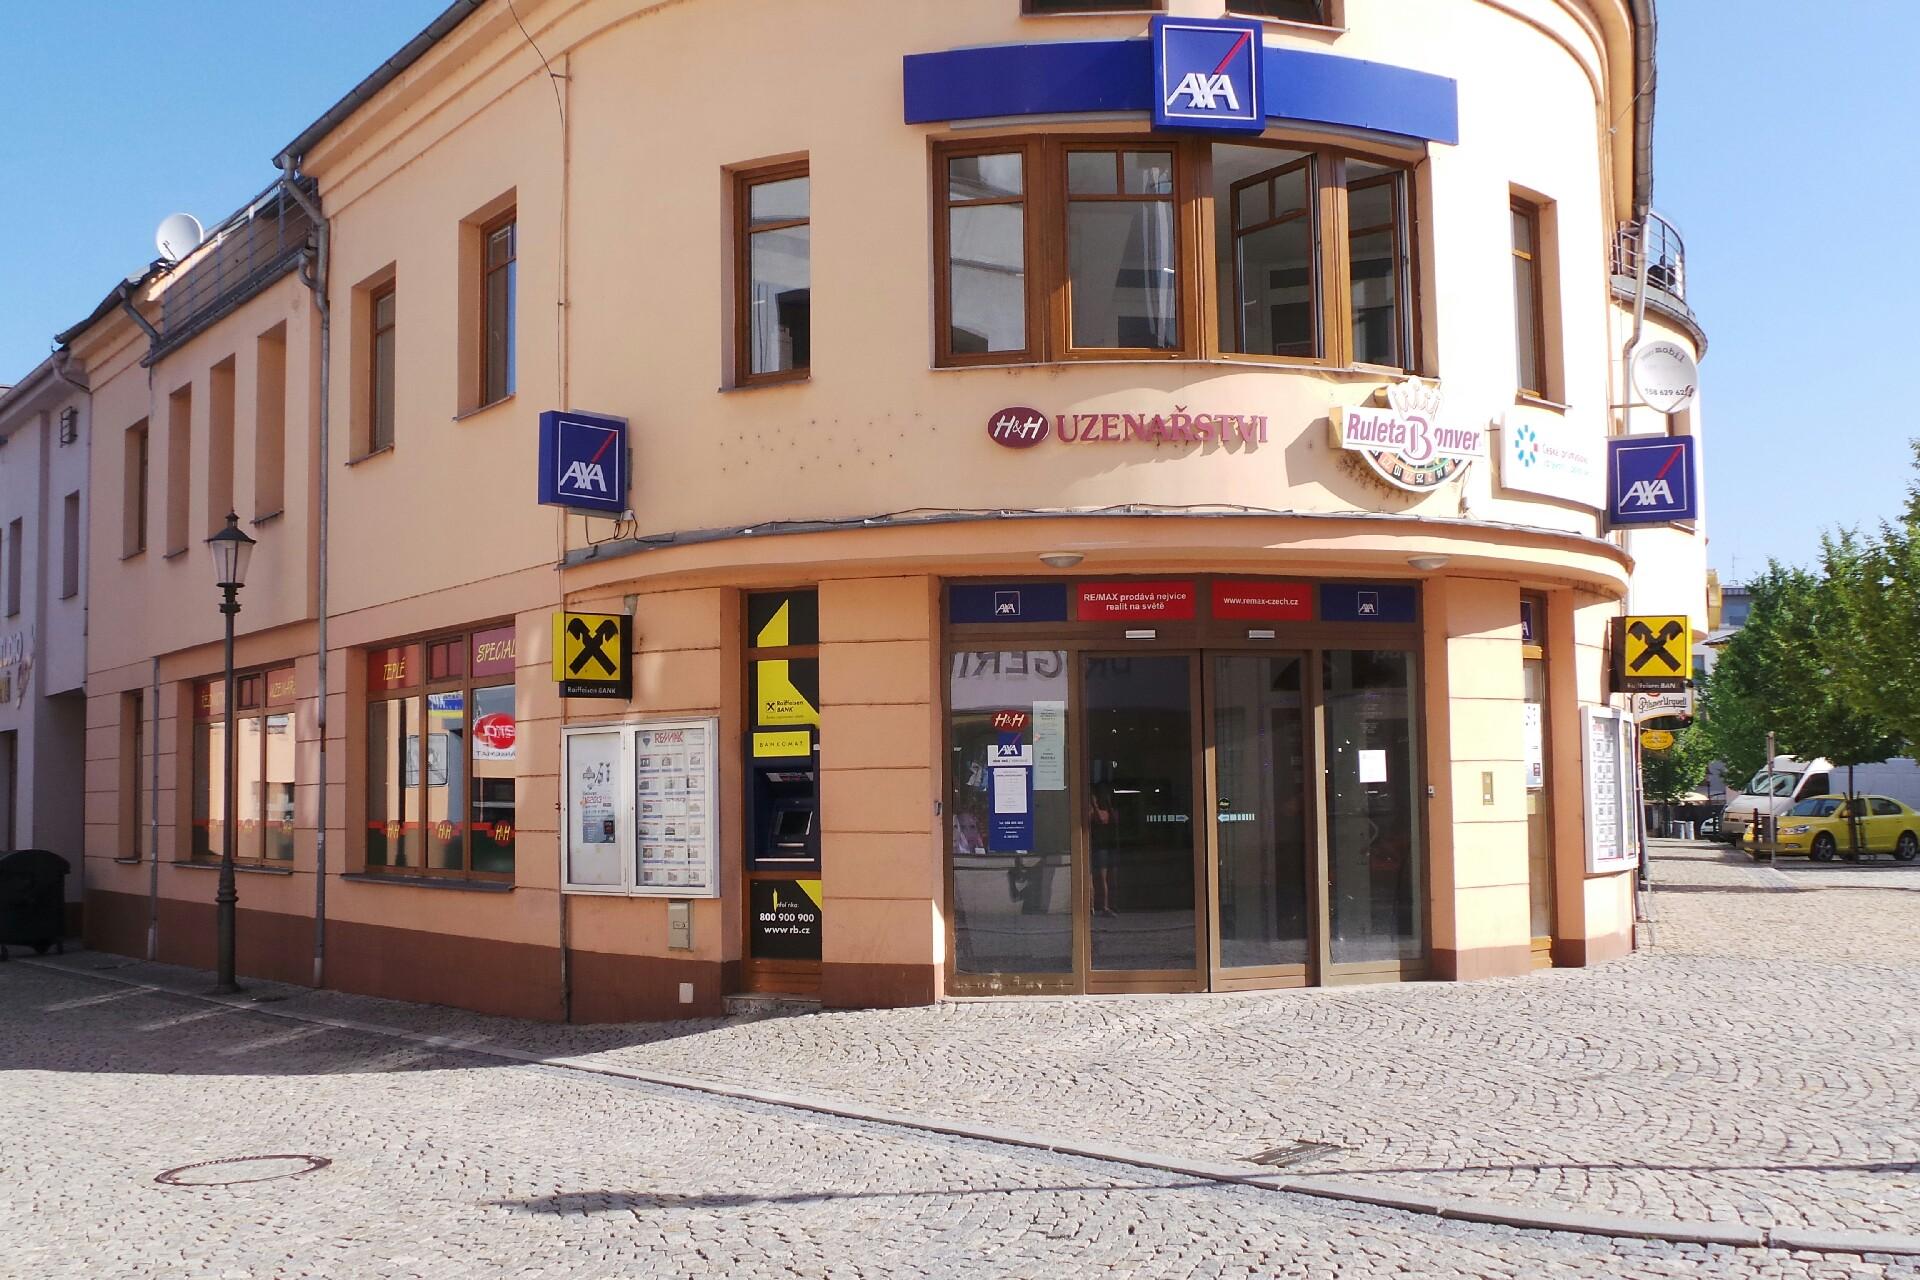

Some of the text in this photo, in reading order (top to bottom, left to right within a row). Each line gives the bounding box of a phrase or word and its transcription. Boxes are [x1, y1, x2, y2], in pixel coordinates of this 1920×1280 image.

[1166, 72, 1240, 110] AXA
[993, 414, 1044, 440] H&H
[1346, 412, 1481, 462] Ruleta Bonver
[558, 460, 608, 493] AXA
[1618, 479, 1675, 507] AXA
[1083, 592, 1119, 601] RE/MAX
[1119, 592, 1155, 603] prodává
[1223, 596, 1299, 606] www.remax-czech.cz
[995, 603, 1016, 613] AXA
[1105, 603, 1128, 611] realit
[1142, 602, 1165, 611] světě
[1358, 603, 1375, 613] AXA
[383, 655, 406, 681] TEPLÉ
[776, 705, 794, 713] BANK
[994, 713, 1026, 728] H&H
[759, 740, 804, 748] BANKOMAT
[998, 744, 1019, 755] AXA
[759, 912, 815, 922] 800 900 900
[763, 924, 812, 935] www.rb.cz
